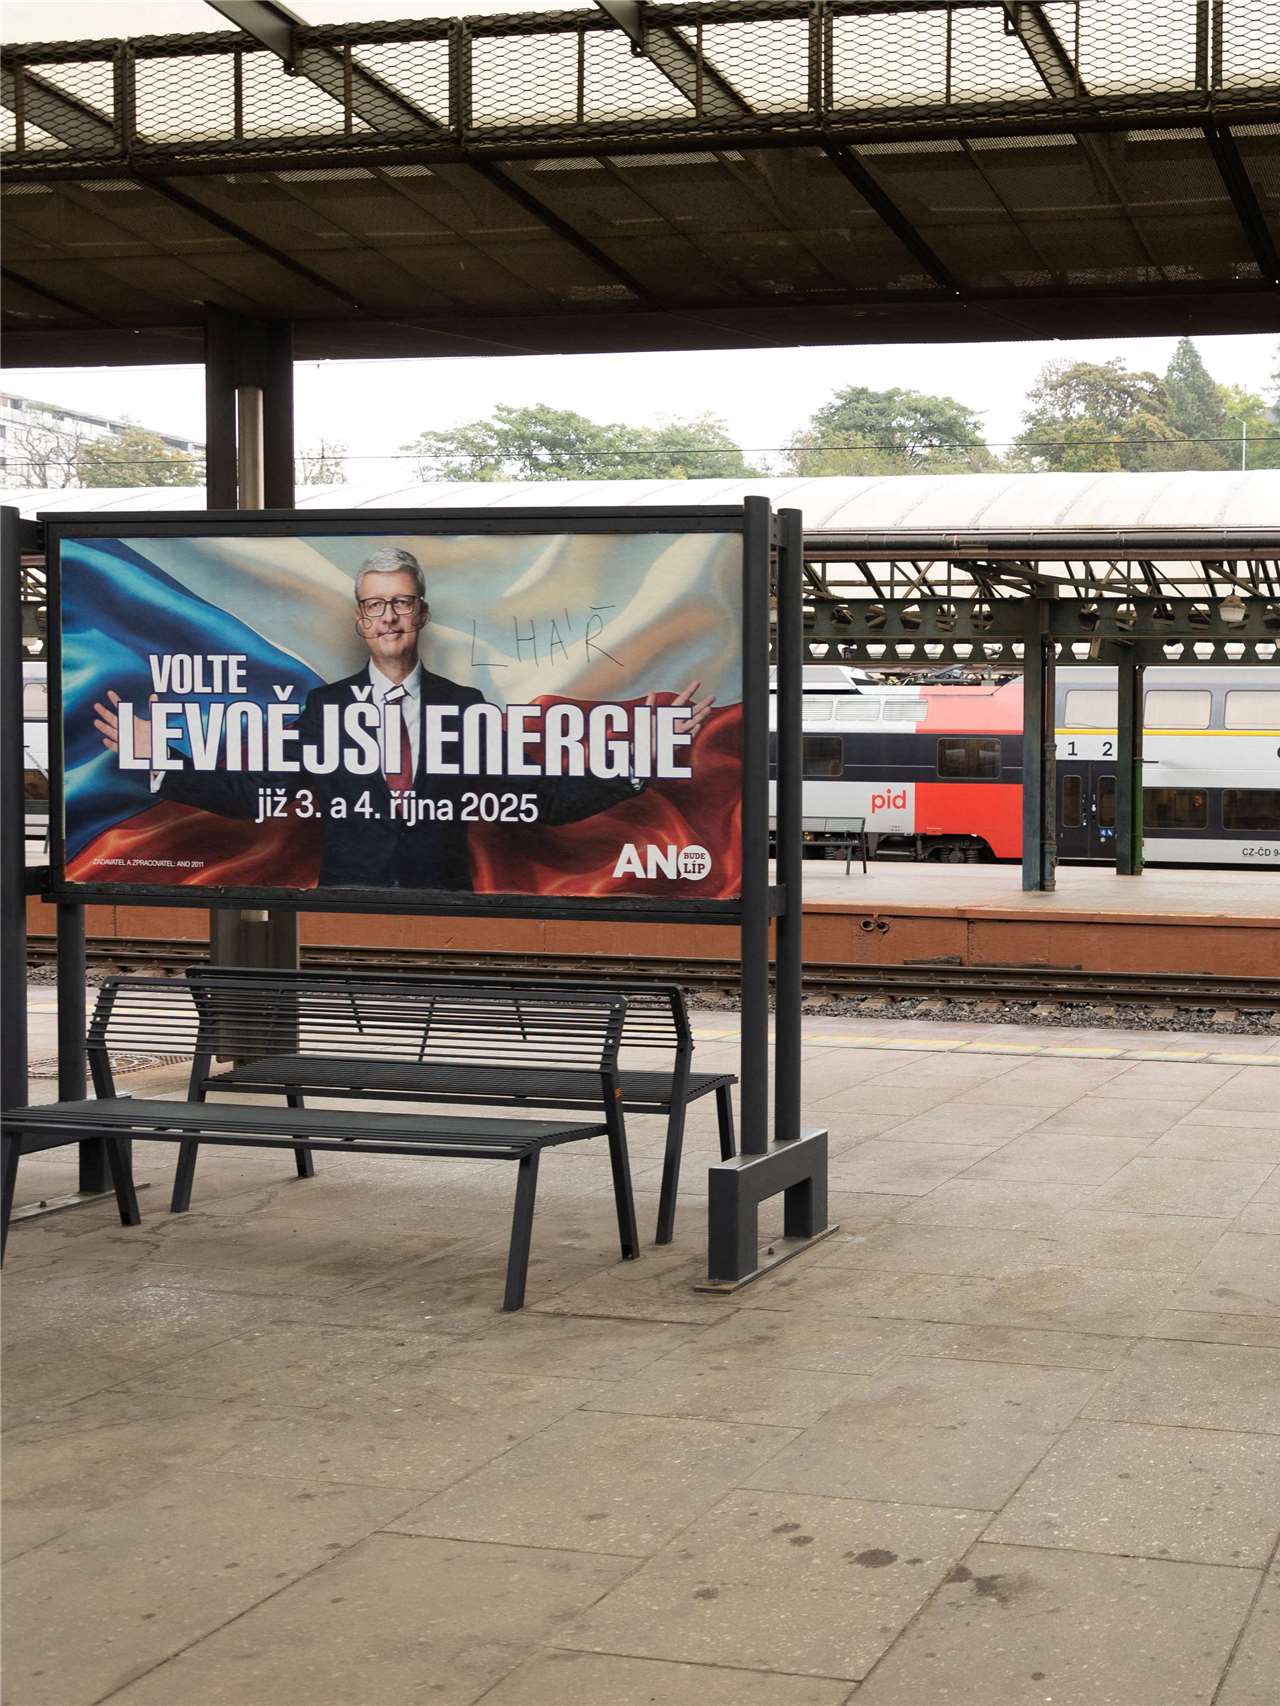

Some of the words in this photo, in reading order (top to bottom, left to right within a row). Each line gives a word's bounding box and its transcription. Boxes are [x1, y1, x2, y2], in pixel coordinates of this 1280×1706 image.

[149, 653, 248, 695] VOLTE
[117, 684, 407, 775] LEVNĚJŠÍ
[425, 702, 693, 780] ENERGIE
[1067, 741, 1078, 757] 1
[1102, 741, 1113, 757] 2
[255, 788, 288, 823] již
[295, 789, 322, 819] 3.
[330, 797, 347, 818] a
[354, 791, 381, 819] 4.
[390, 790, 453, 827] října
[460, 792, 539, 822] 2025
[871, 788, 907, 814] pid
[683, 852, 706, 860] BUDE
[683, 859, 706, 874] LÍP
